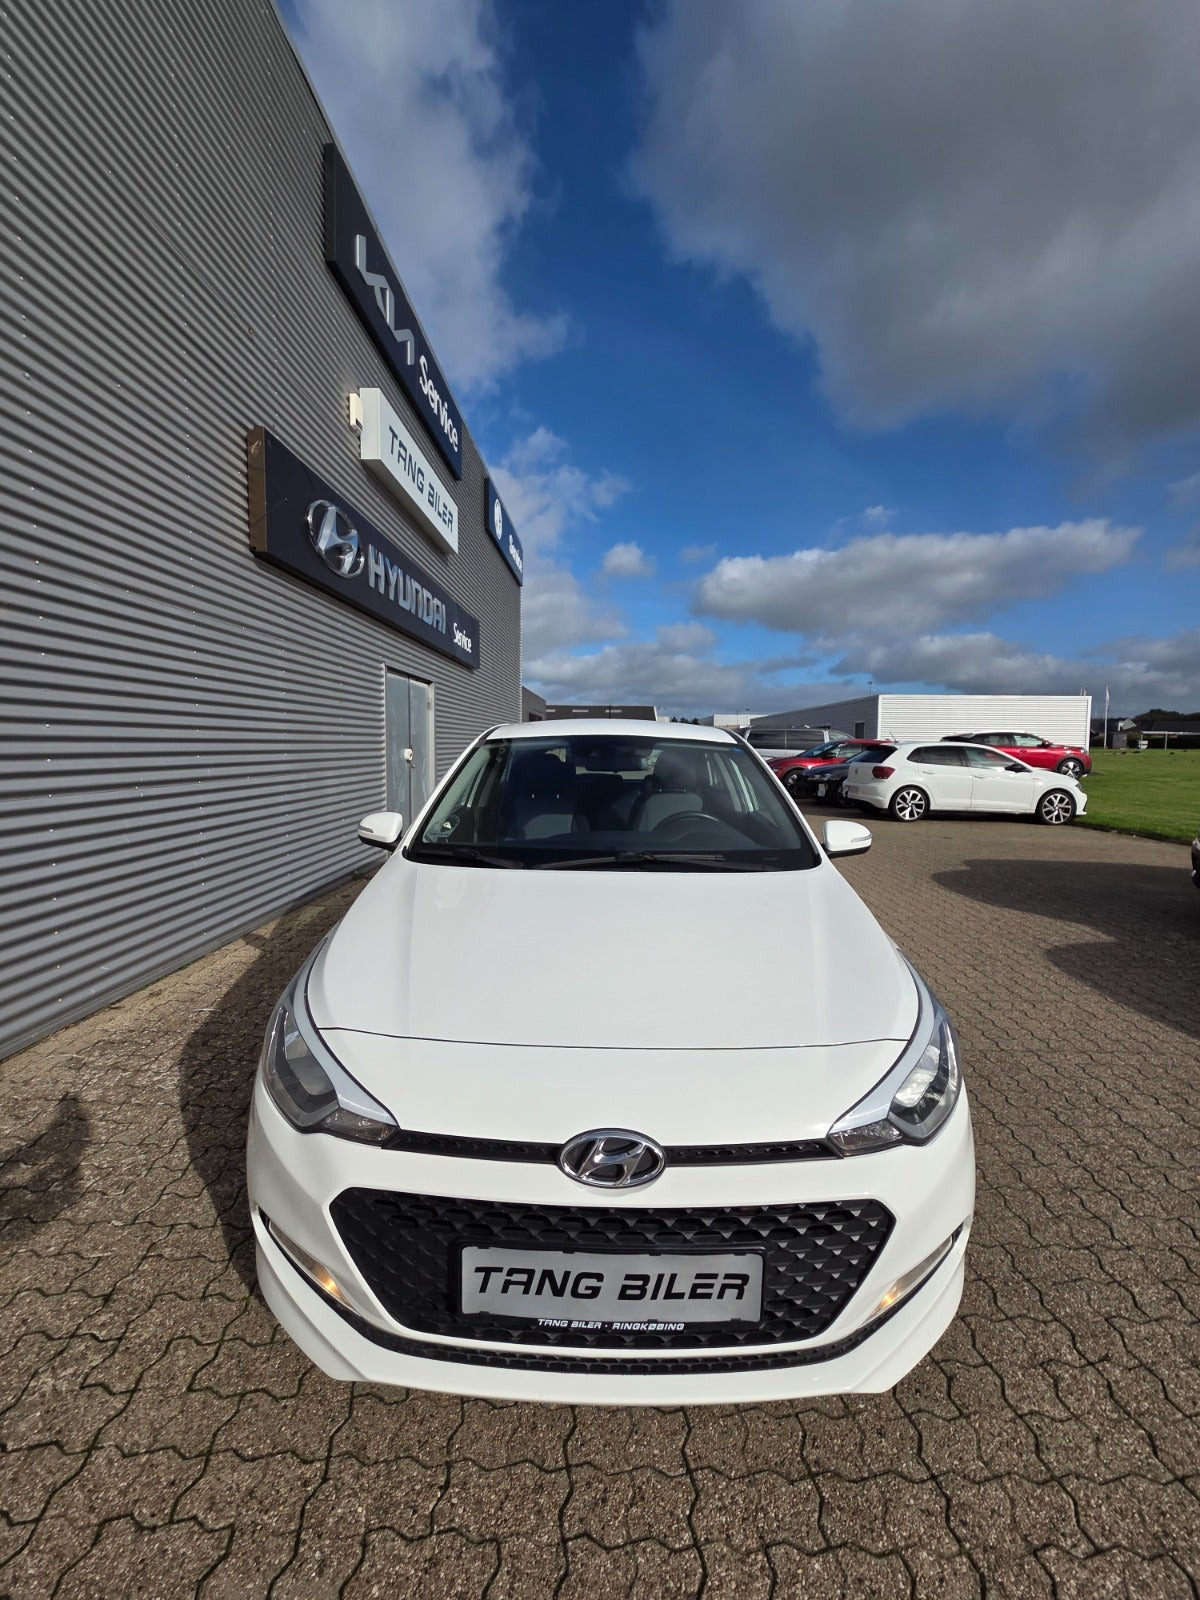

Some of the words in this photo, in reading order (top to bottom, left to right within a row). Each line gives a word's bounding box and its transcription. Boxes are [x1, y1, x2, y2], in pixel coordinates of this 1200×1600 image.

[419, 354, 459, 452] Service
[389, 424, 425, 495] TANG
[427, 482, 454, 533] BILER
[368, 543, 447, 635] HYUNDAI
[453, 622, 472, 653] Service
[474, 1266, 604, 1300] TANG
[617, 1272, 750, 1301] BILER
[537, 1318, 568, 1328] TANG
[571, 1320, 602, 1330] BILER
[612, 1322, 684, 1331] RINGKØBING
